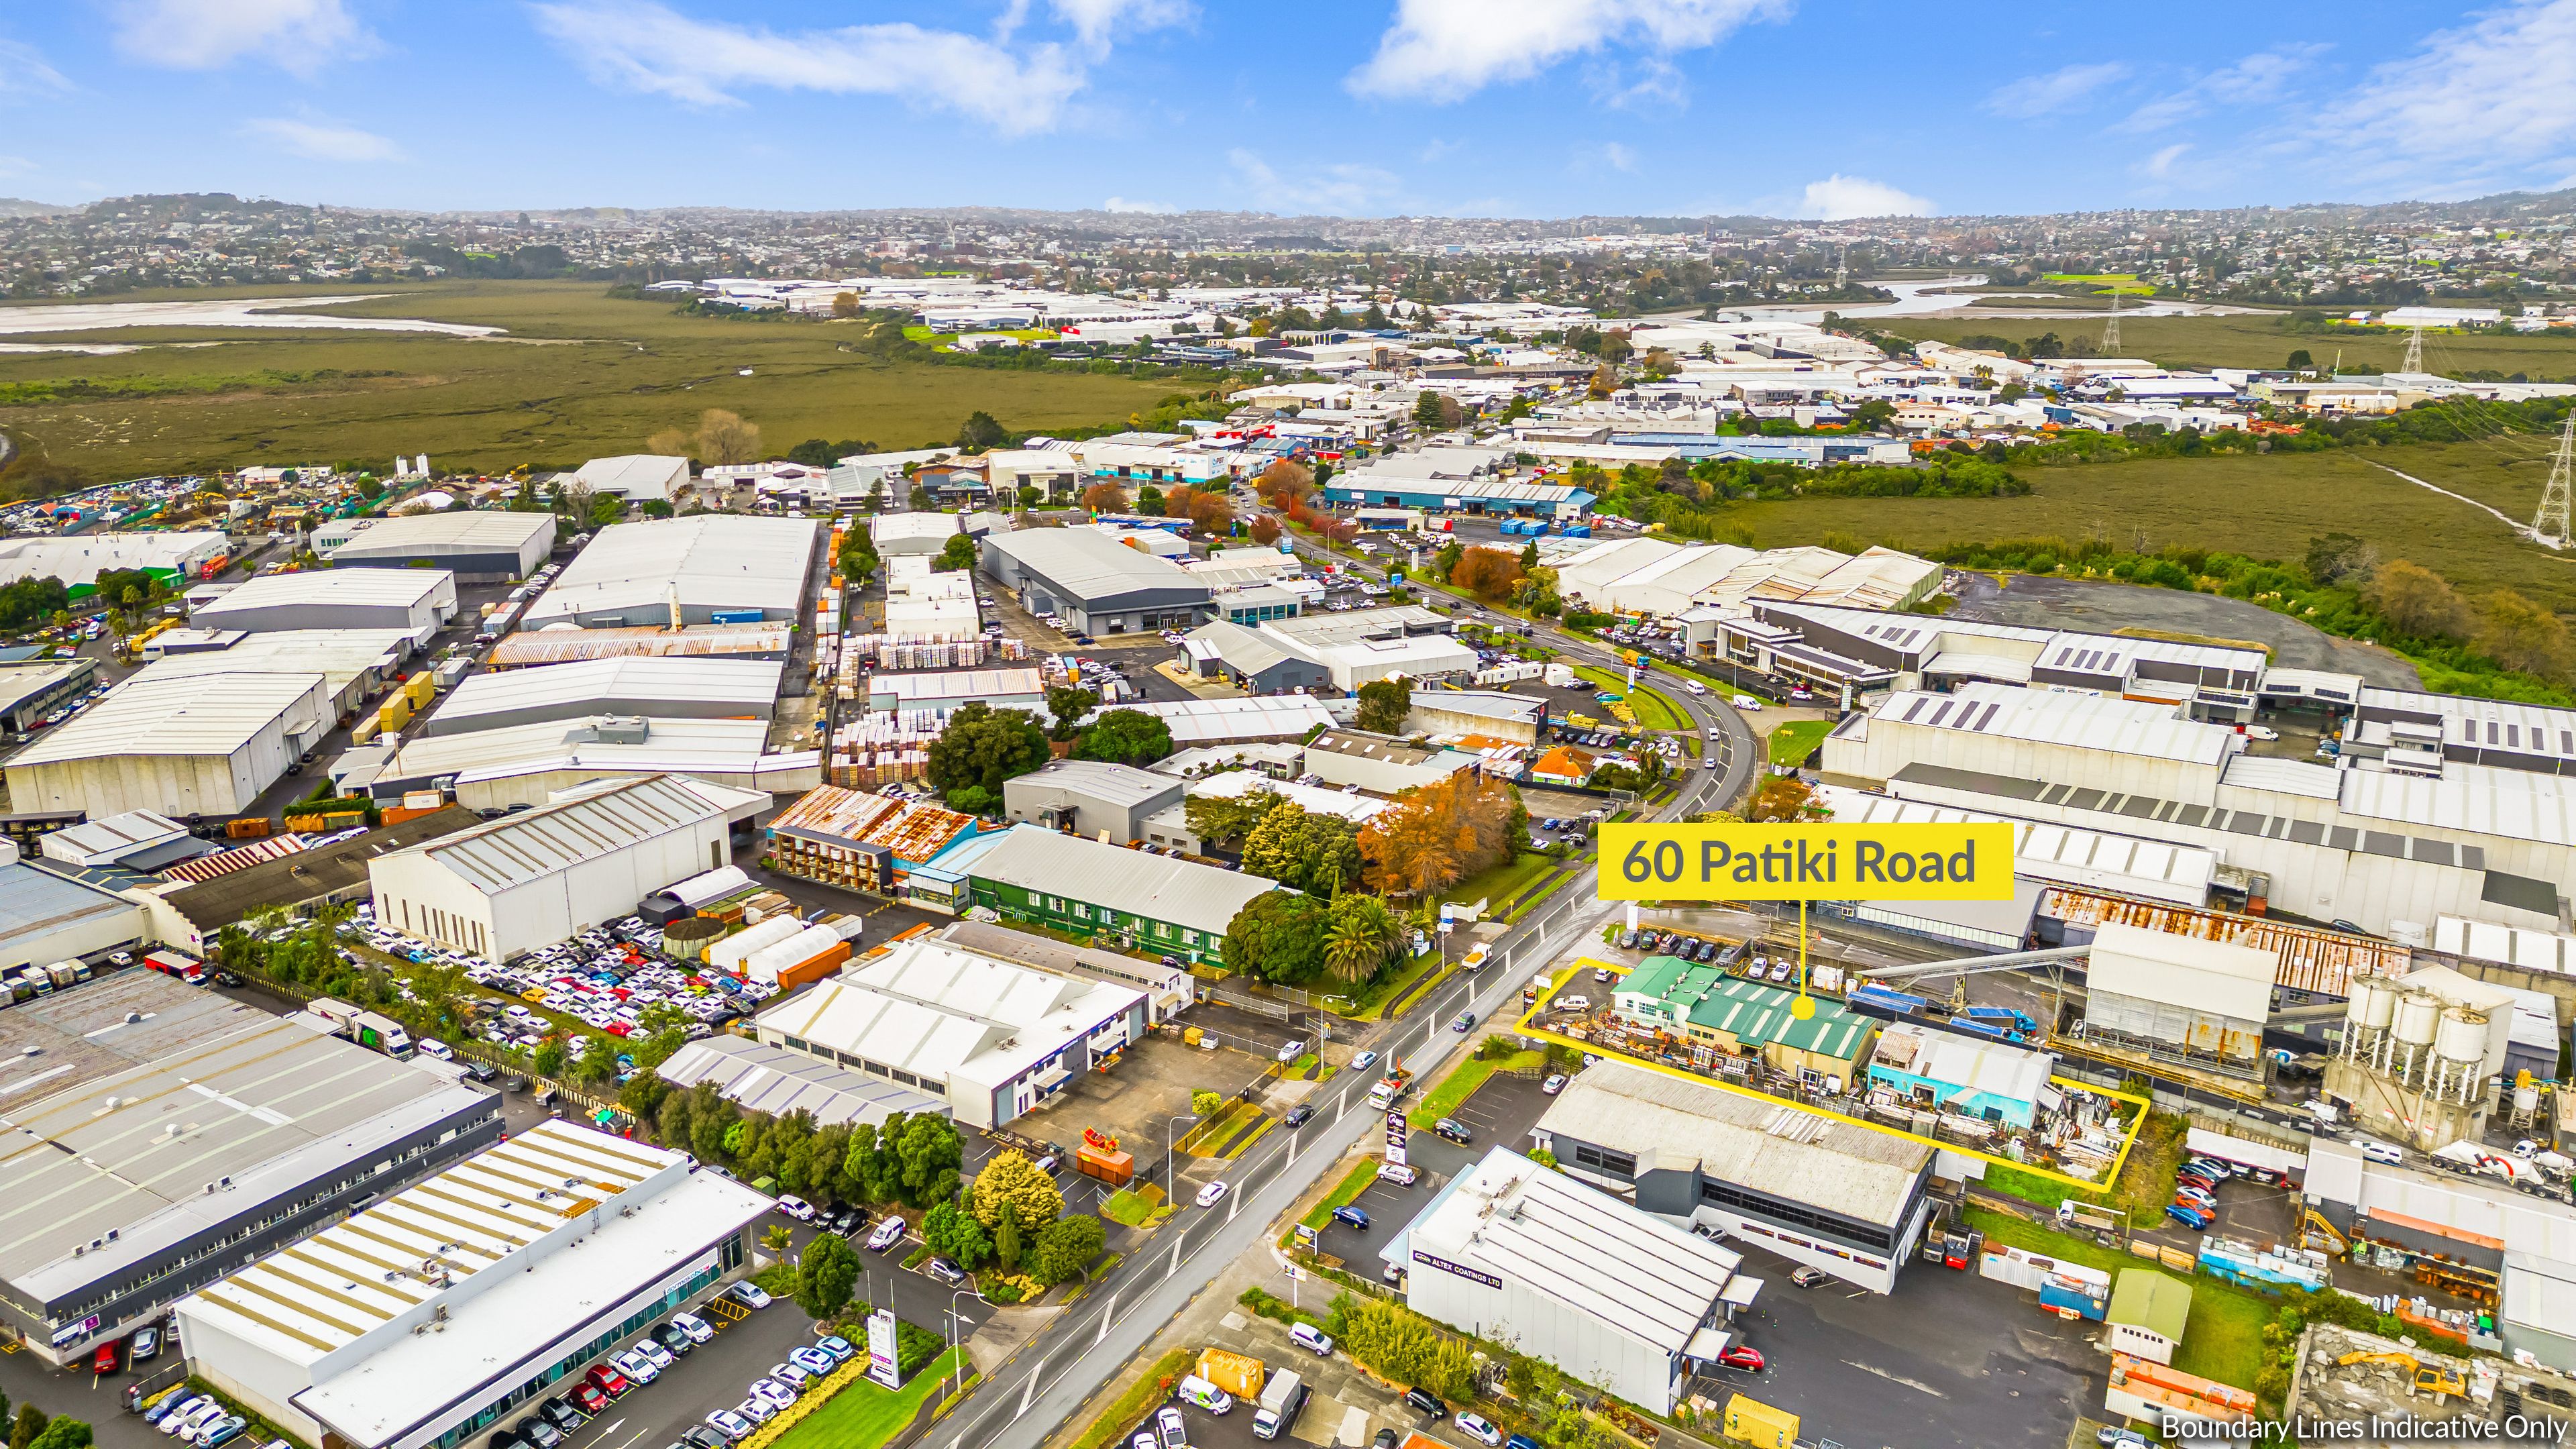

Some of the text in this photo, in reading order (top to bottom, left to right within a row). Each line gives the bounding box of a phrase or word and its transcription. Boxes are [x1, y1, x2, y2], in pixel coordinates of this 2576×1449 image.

[667, 1268, 703, 1293] dormakaba
[1432, 1259, 1500, 1287] ALTEX COATINGS LTD
